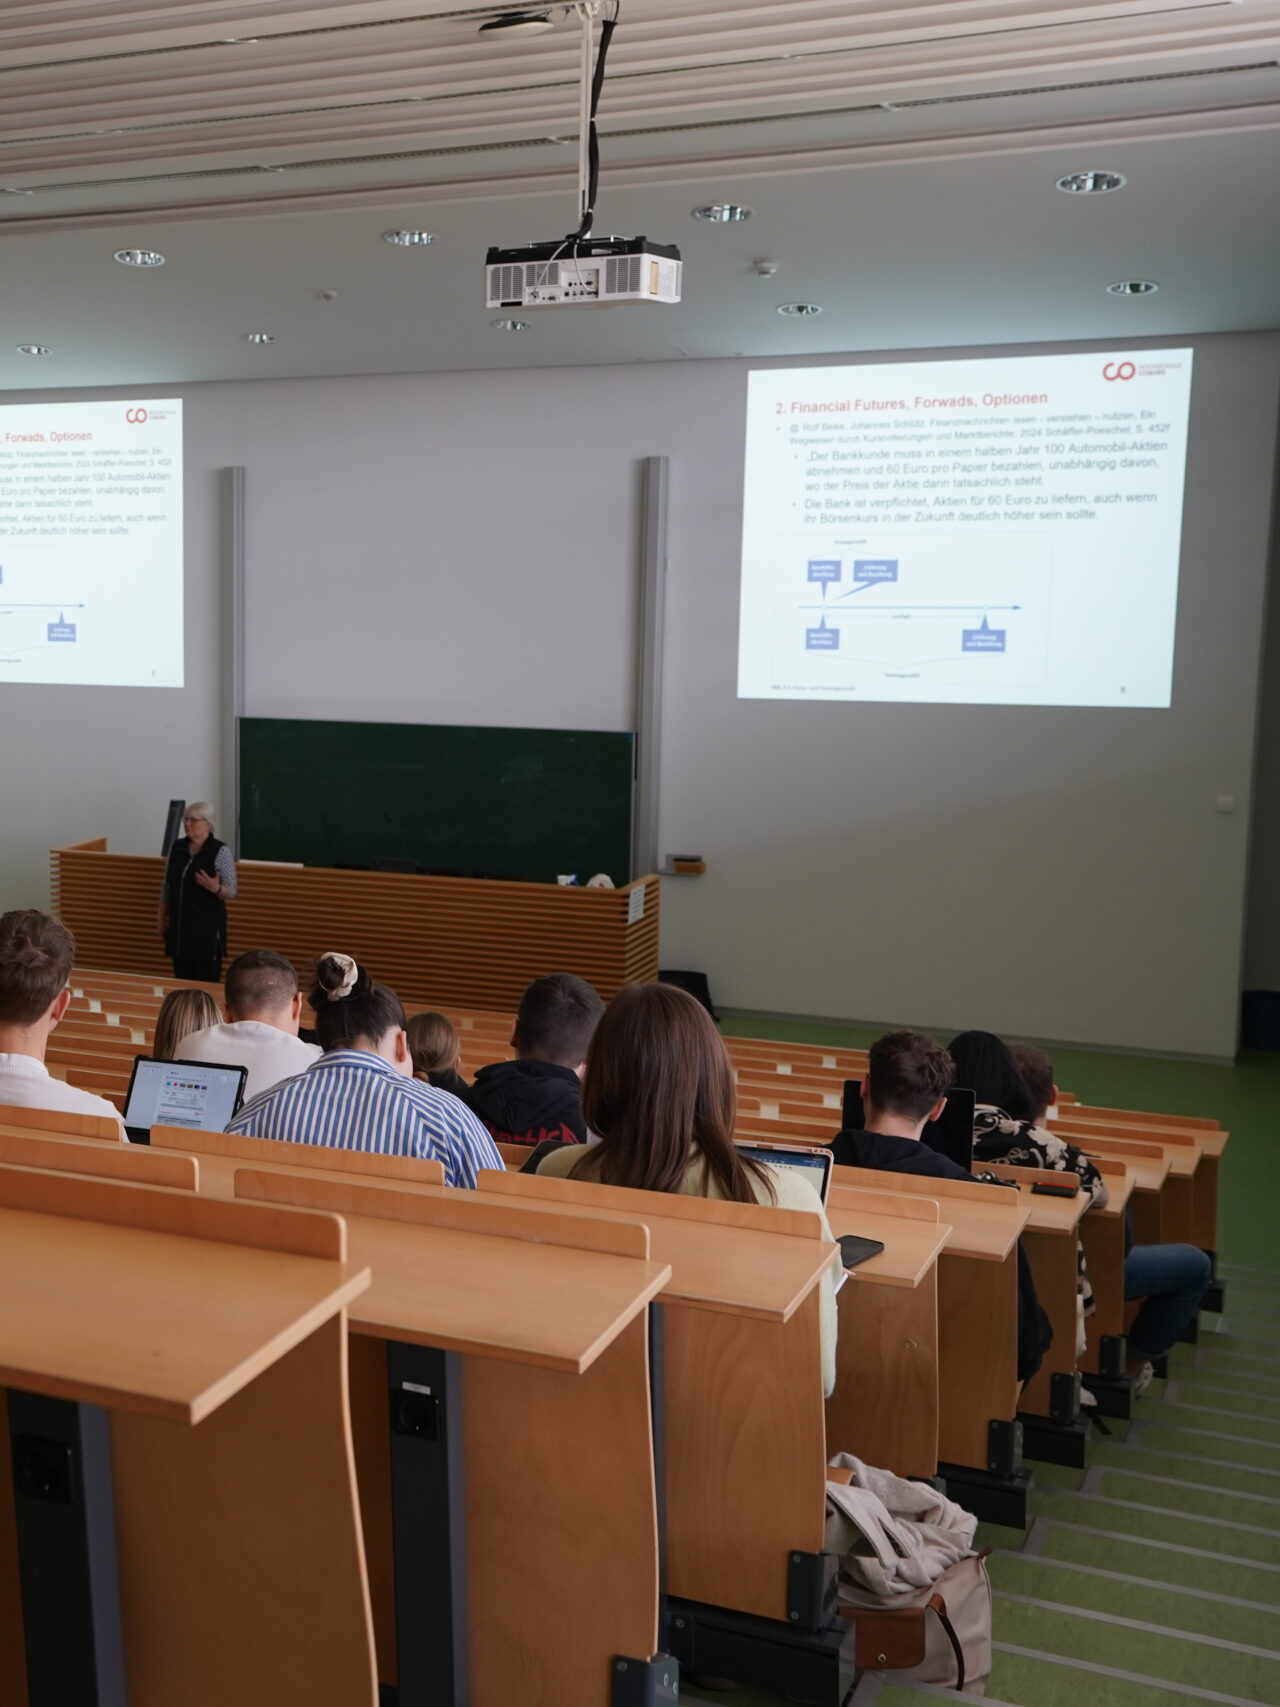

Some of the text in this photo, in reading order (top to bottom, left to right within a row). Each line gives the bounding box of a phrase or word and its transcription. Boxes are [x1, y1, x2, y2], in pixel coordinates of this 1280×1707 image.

[776, 402, 787, 414] 2.
[791, 400, 850, 413] Financial
[855, 399, 910, 412] Futures,
[982, 393, 1048, 408] Optionen
[50, 431, 93, 443] Optionen
[832, 450, 890, 461] Bankkunde
[894, 449, 922, 459] muss
[926, 448, 936, 458] in
[938, 448, 972, 458] einem
[975, 446, 1012, 457] halben
[1016, 445, 1040, 456] Jahr
[1045, 444, 1064, 454] 100
[1068, 440, 1168, 454] Automobil-Aktien
[806, 457, 1160, 477] abnehmen und 60 Euro pro Papier bezahlen, unabhängig davon,
[806, 482, 820, 491] wo
[824, 481, 840, 491] der
[843, 480, 870, 490] Preis
[873, 479, 890, 490] der
[892, 478, 920, 489] Aktie
[923, 478, 950, 489] dann
[804, 498, 822, 509] Die
[825, 498, 851, 509] Bank
[854, 498, 867, 508] ist
[933, 496, 968, 507] Aktien
[970, 494, 985, 505] für
[988, 494, 1002, 505] 60
[1005, 494, 1032, 505] Euro
[1034, 495, 1049, 505] zu
[1051, 493, 1090, 505] liefern,
[1094, 492, 1122, 503] auch
[1125, 493, 1158, 503] wenn
[804, 513, 817, 523] ihr
[820, 512, 879, 523] Börsenkurs
[882, 512, 891, 522] in
[894, 511, 912, 522] der
[914, 511, 955, 522] Zukunft
[958, 510, 1001, 522] deutlich
[1003, 509, 1036, 520] höher
[1039, 509, 1062, 520] sein
